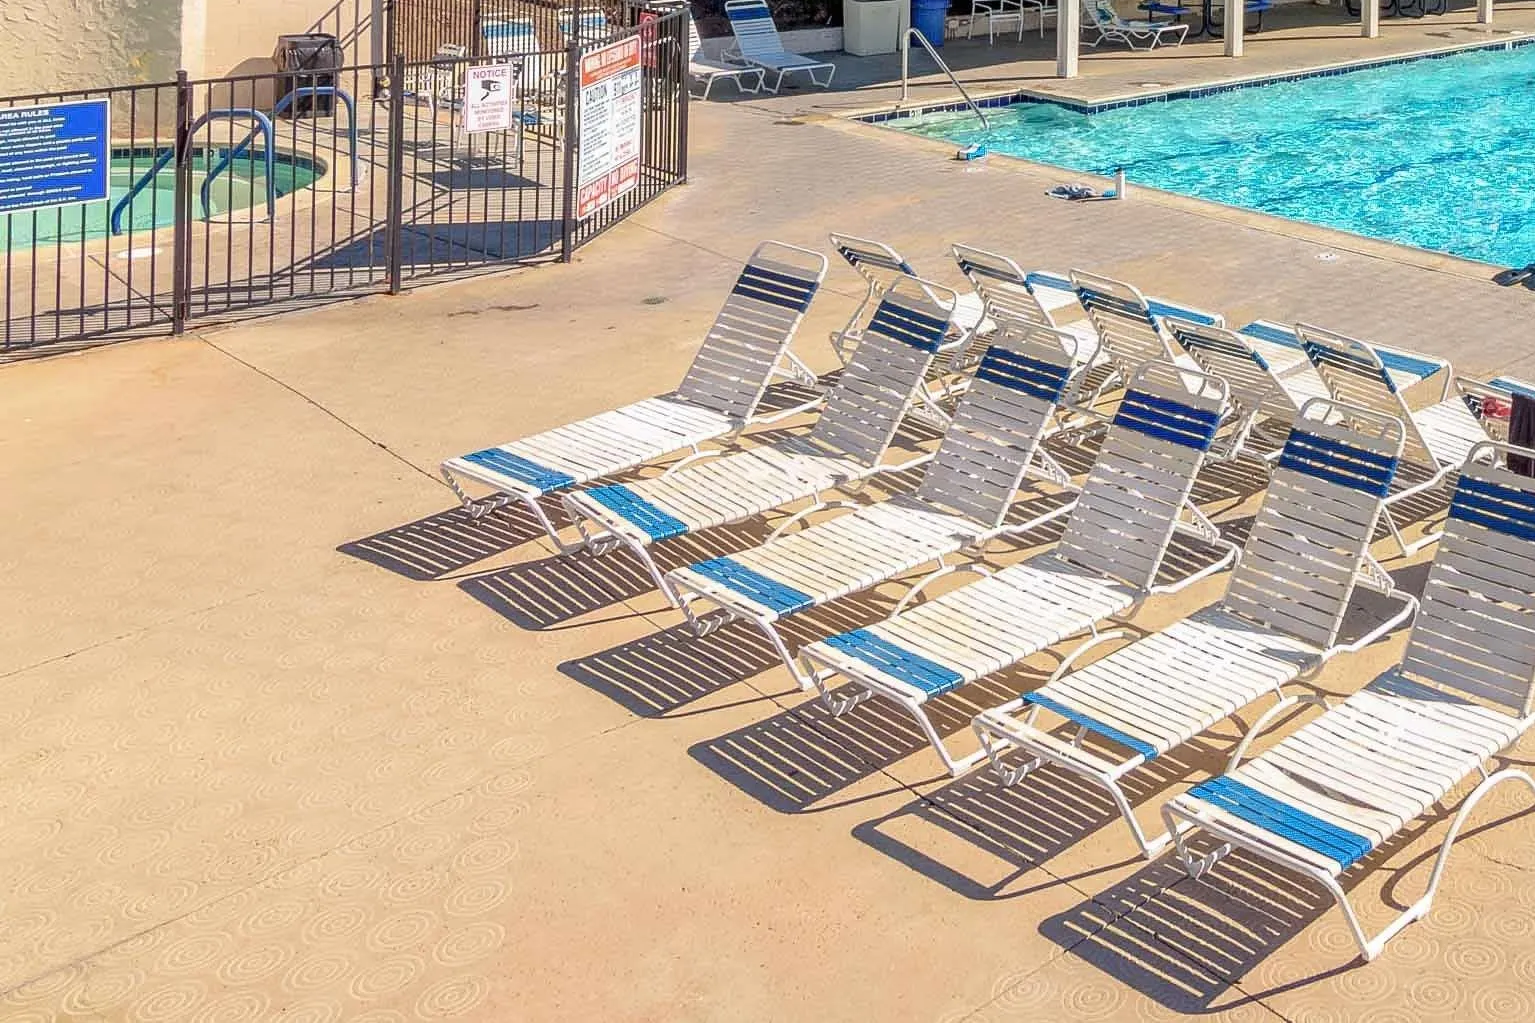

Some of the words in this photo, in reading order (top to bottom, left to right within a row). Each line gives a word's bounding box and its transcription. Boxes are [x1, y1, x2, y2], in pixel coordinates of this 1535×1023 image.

[473, 68, 507, 80] NOTICE
[585, 83, 608, 105] CAUTION
[21, 109, 50, 118] RULES
